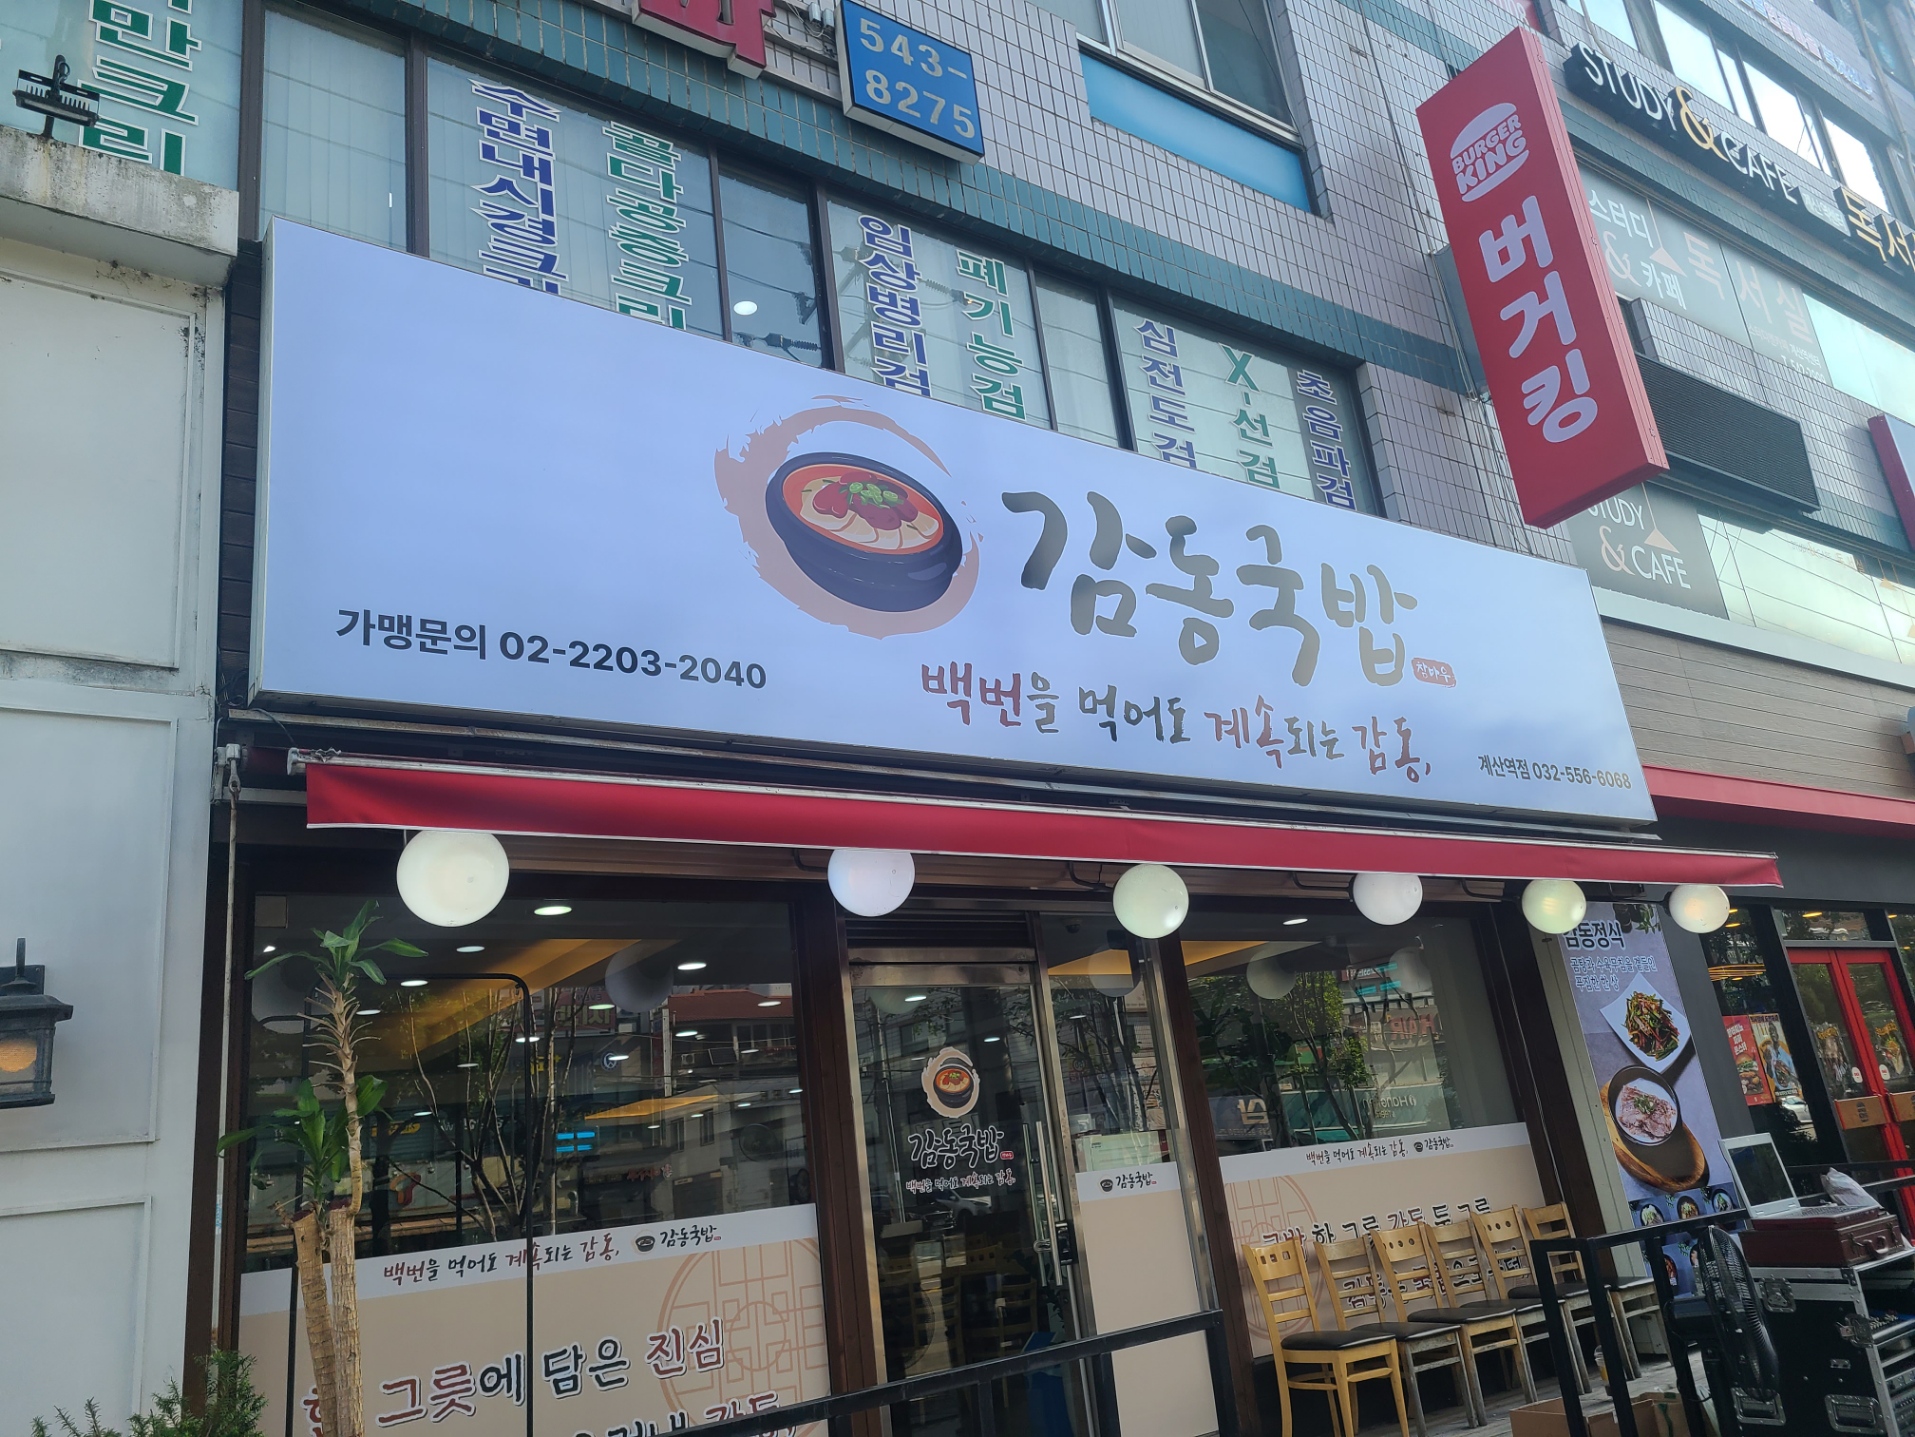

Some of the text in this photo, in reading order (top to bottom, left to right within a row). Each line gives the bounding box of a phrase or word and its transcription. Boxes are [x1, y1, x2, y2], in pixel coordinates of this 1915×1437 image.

[859, 17, 968, 80] 543-
[864, 69, 975, 139] 8275
[1578, 42, 1678, 131] STUDY
[1721, 131, 1798, 205] CAFE
[1452, 114, 1522, 174] BURGER
[1456, 129, 1527, 195] KING
[1589, 190, 1654, 249] 스터디
[1842, 187, 1915, 274] 독서
[1640, 260, 1687, 311] 카페
[1478, 195, 1598, 443] 버거킹
[1218, 342, 1280, 489] X-선검
[1296, 368, 1356, 511] 초음파검
[1001, 490, 1418, 687] 감동국밥
[1631, 545, 1692, 590] CAFE
[336, 608, 767, 689] 가맹문의 02-2203-2040
[921, 660, 1432, 783] 백번을 먹어도 계속되는 감동,
[1478, 754, 1632, 789] 계산역점 032-556-6068
[908, 1123, 1004, 1169] 감동국밥
[1306, 1150, 1330, 1165] 백번을
[1333, 1148, 1355, 1162] 먹어도
[1423, 1136, 1452, 1151] 감동국밥
[1116, 1171, 1153, 1189] 감동국밥
[660, 1224, 717, 1248] 감동국밥
[384, 1258, 440, 1286] 백번을
[448, 1253, 498, 1277] 먹어도
[377, 1353, 525, 1427] 그릇에
[542, 1337, 630, 1396] 담은
[646, 1318, 727, 1379] 진심
